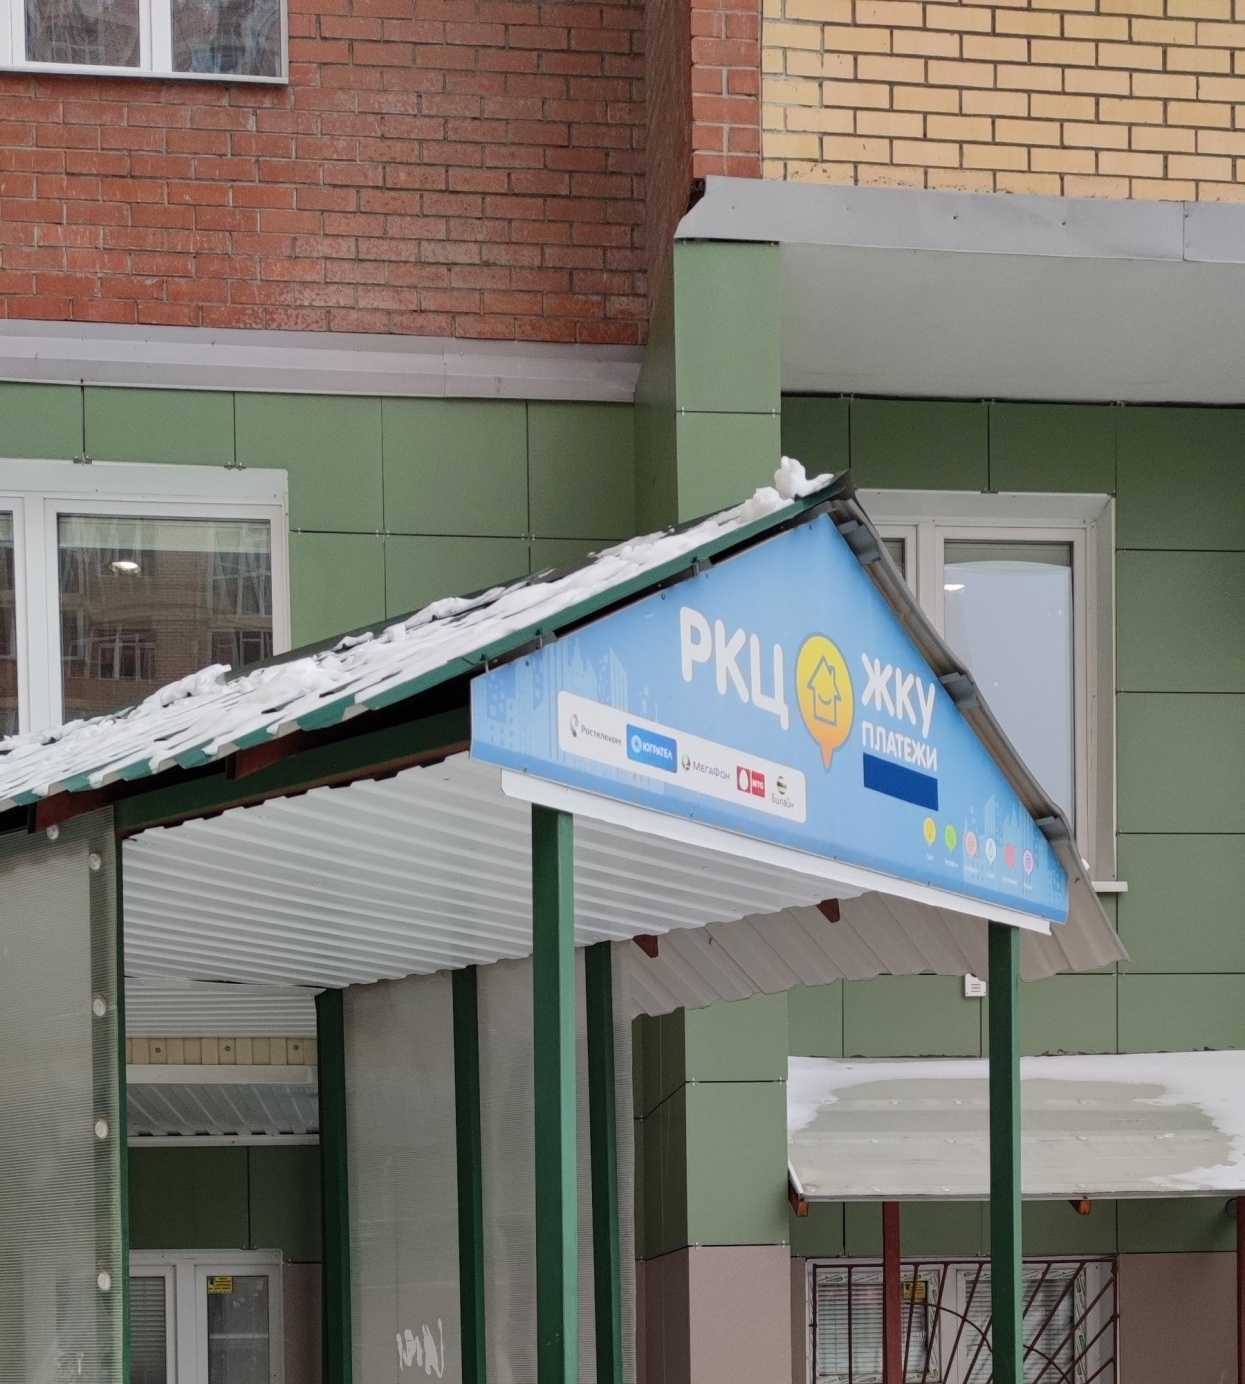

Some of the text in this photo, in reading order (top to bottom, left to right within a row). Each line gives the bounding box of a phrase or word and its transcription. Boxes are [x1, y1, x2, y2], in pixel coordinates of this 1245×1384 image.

[680, 606, 790, 730] РКЦ
[861, 653, 936, 738] ЖКУ
[862, 720, 938, 772] ПЛАТЕЖИ
